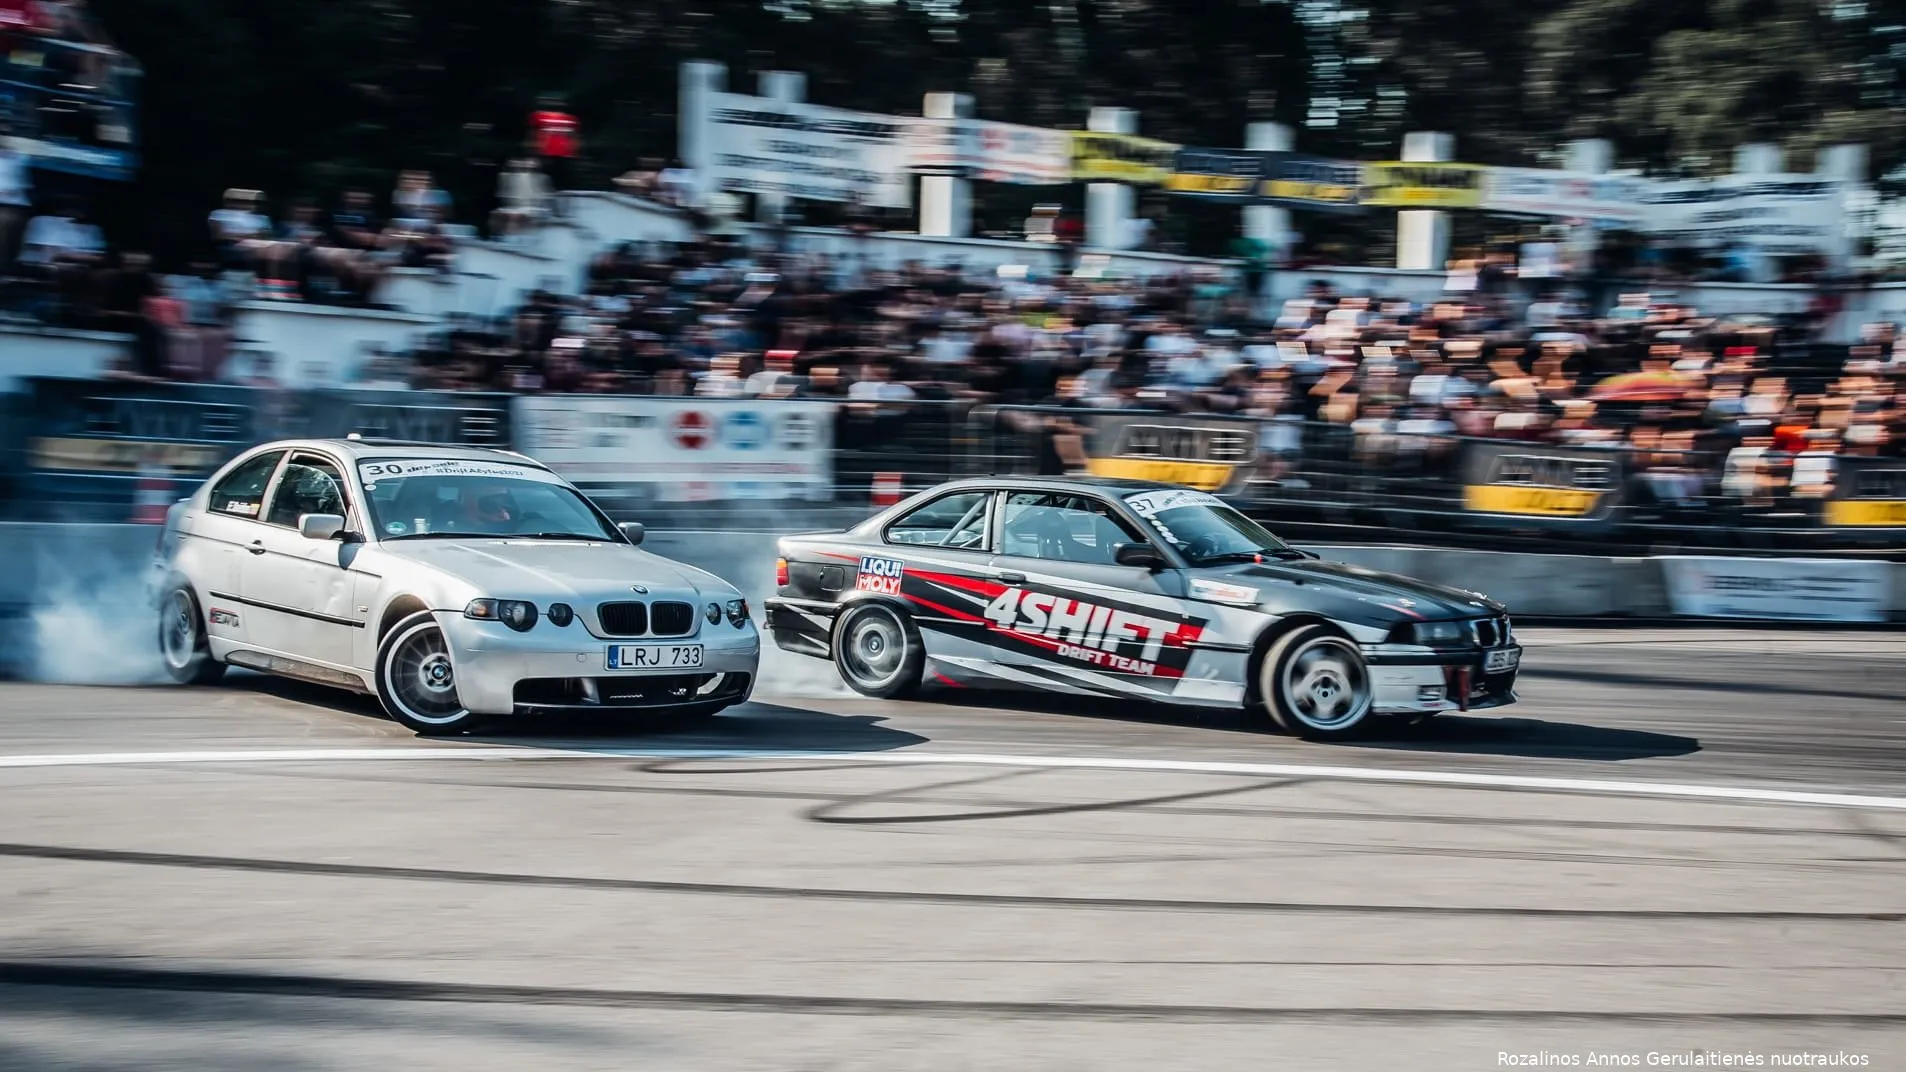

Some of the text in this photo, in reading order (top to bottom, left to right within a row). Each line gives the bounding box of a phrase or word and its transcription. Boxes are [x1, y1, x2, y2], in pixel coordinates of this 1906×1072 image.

[366, 464, 403, 475] 30
[1128, 498, 1155, 511] 37
[860, 557, 902, 577] LIQUI
[857, 575, 900, 594] MOLY
[984, 587, 1182, 662] 4SHIFT
[621, 646, 700, 666] LRJ 733
[1057, 643, 1156, 676] DRIFT TEAM
